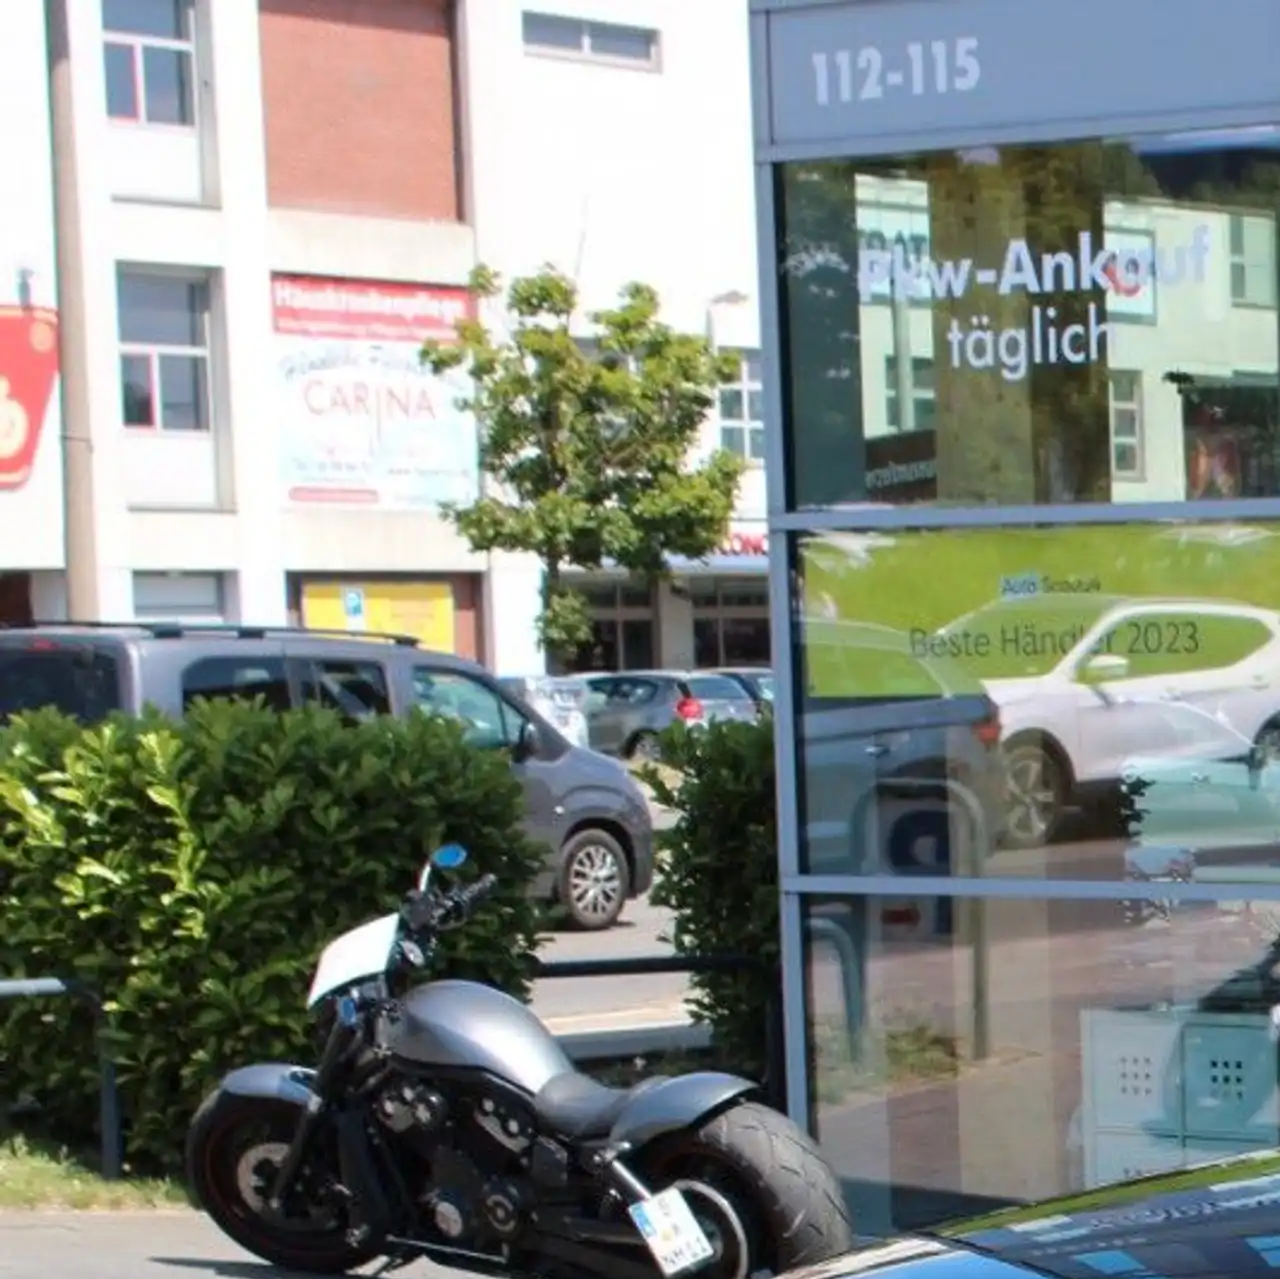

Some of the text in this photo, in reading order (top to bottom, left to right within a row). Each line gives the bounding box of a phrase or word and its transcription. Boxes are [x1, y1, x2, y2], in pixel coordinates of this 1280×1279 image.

[811, 36, 982, 106] 112-115
[858, 225, 1210, 302] Pkw-Ankauf
[947, 304, 1116, 382] täglich
[909, 627, 991, 659] Beste
[1127, 621, 1200, 655] 2023
